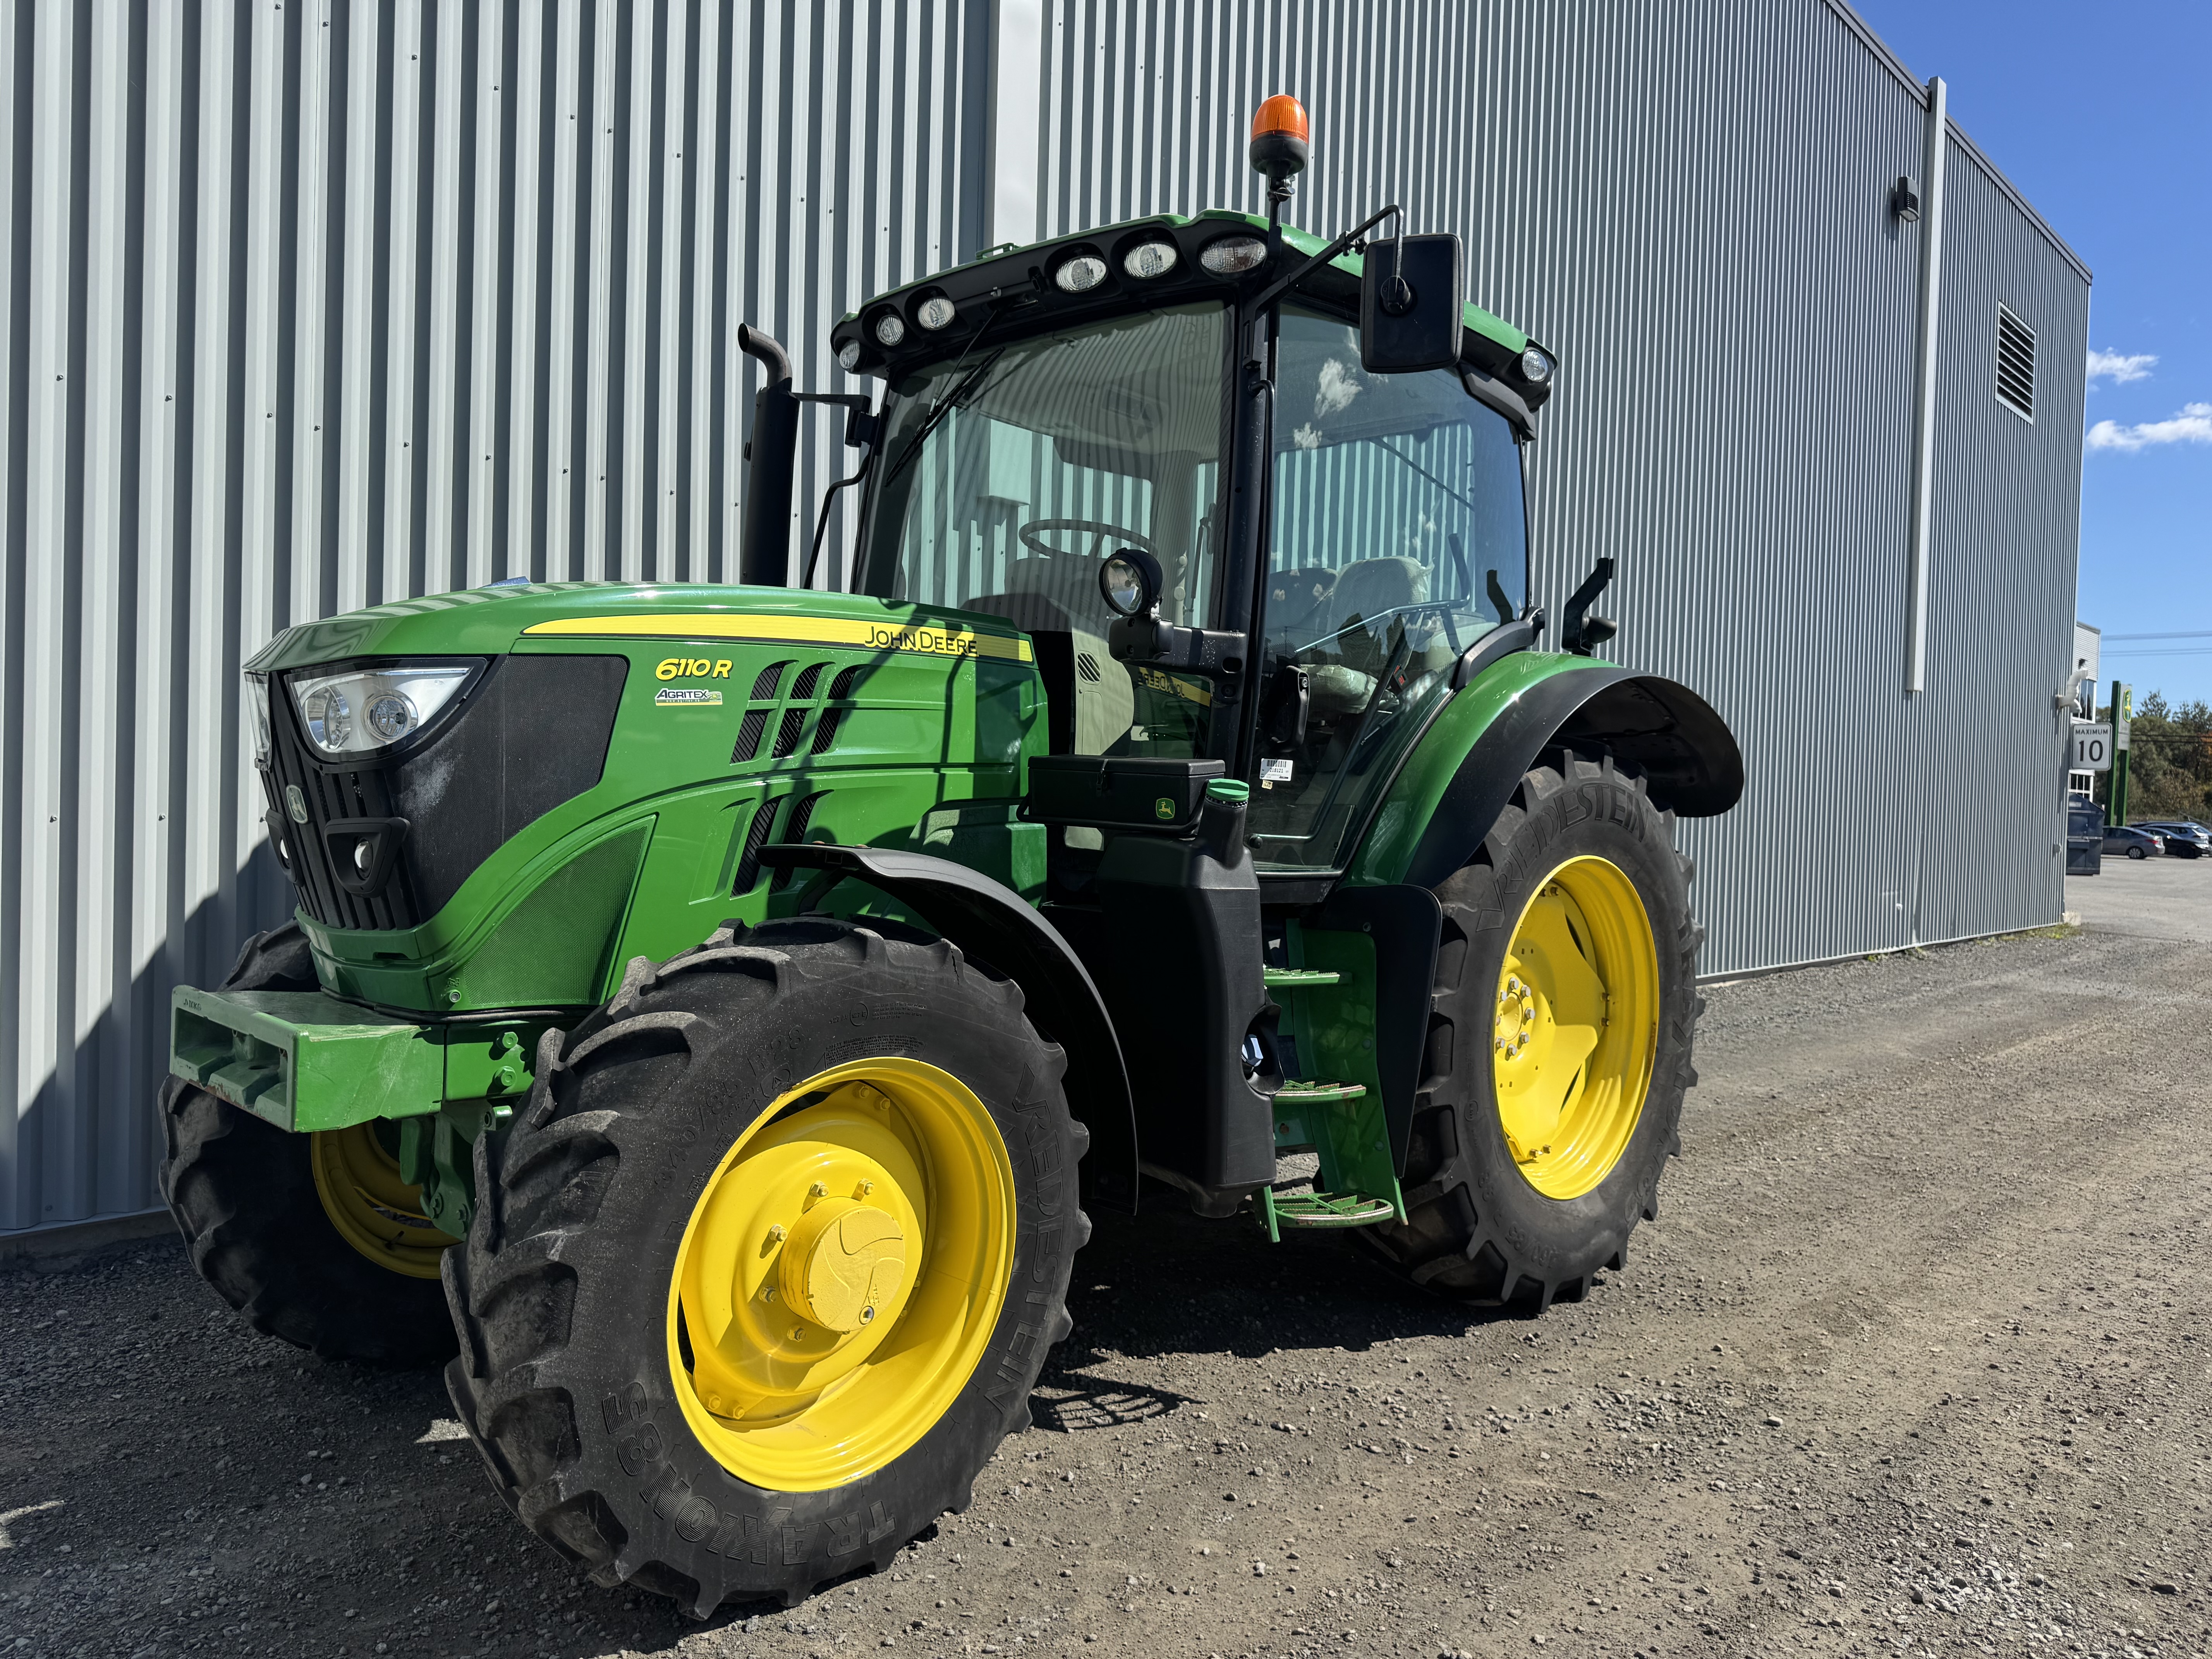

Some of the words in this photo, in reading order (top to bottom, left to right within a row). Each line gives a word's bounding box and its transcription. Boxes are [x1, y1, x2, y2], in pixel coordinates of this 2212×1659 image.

[865, 626, 916, 648] JOHN
[920, 631, 977, 654] DEERE
[656, 690, 708, 699] AGRITEX
[2079, 740, 2103, 762] 10
[984, 1062, 1065, 1413] VREDESTEIN
[639, 1462, 896, 1565] TRAXION
